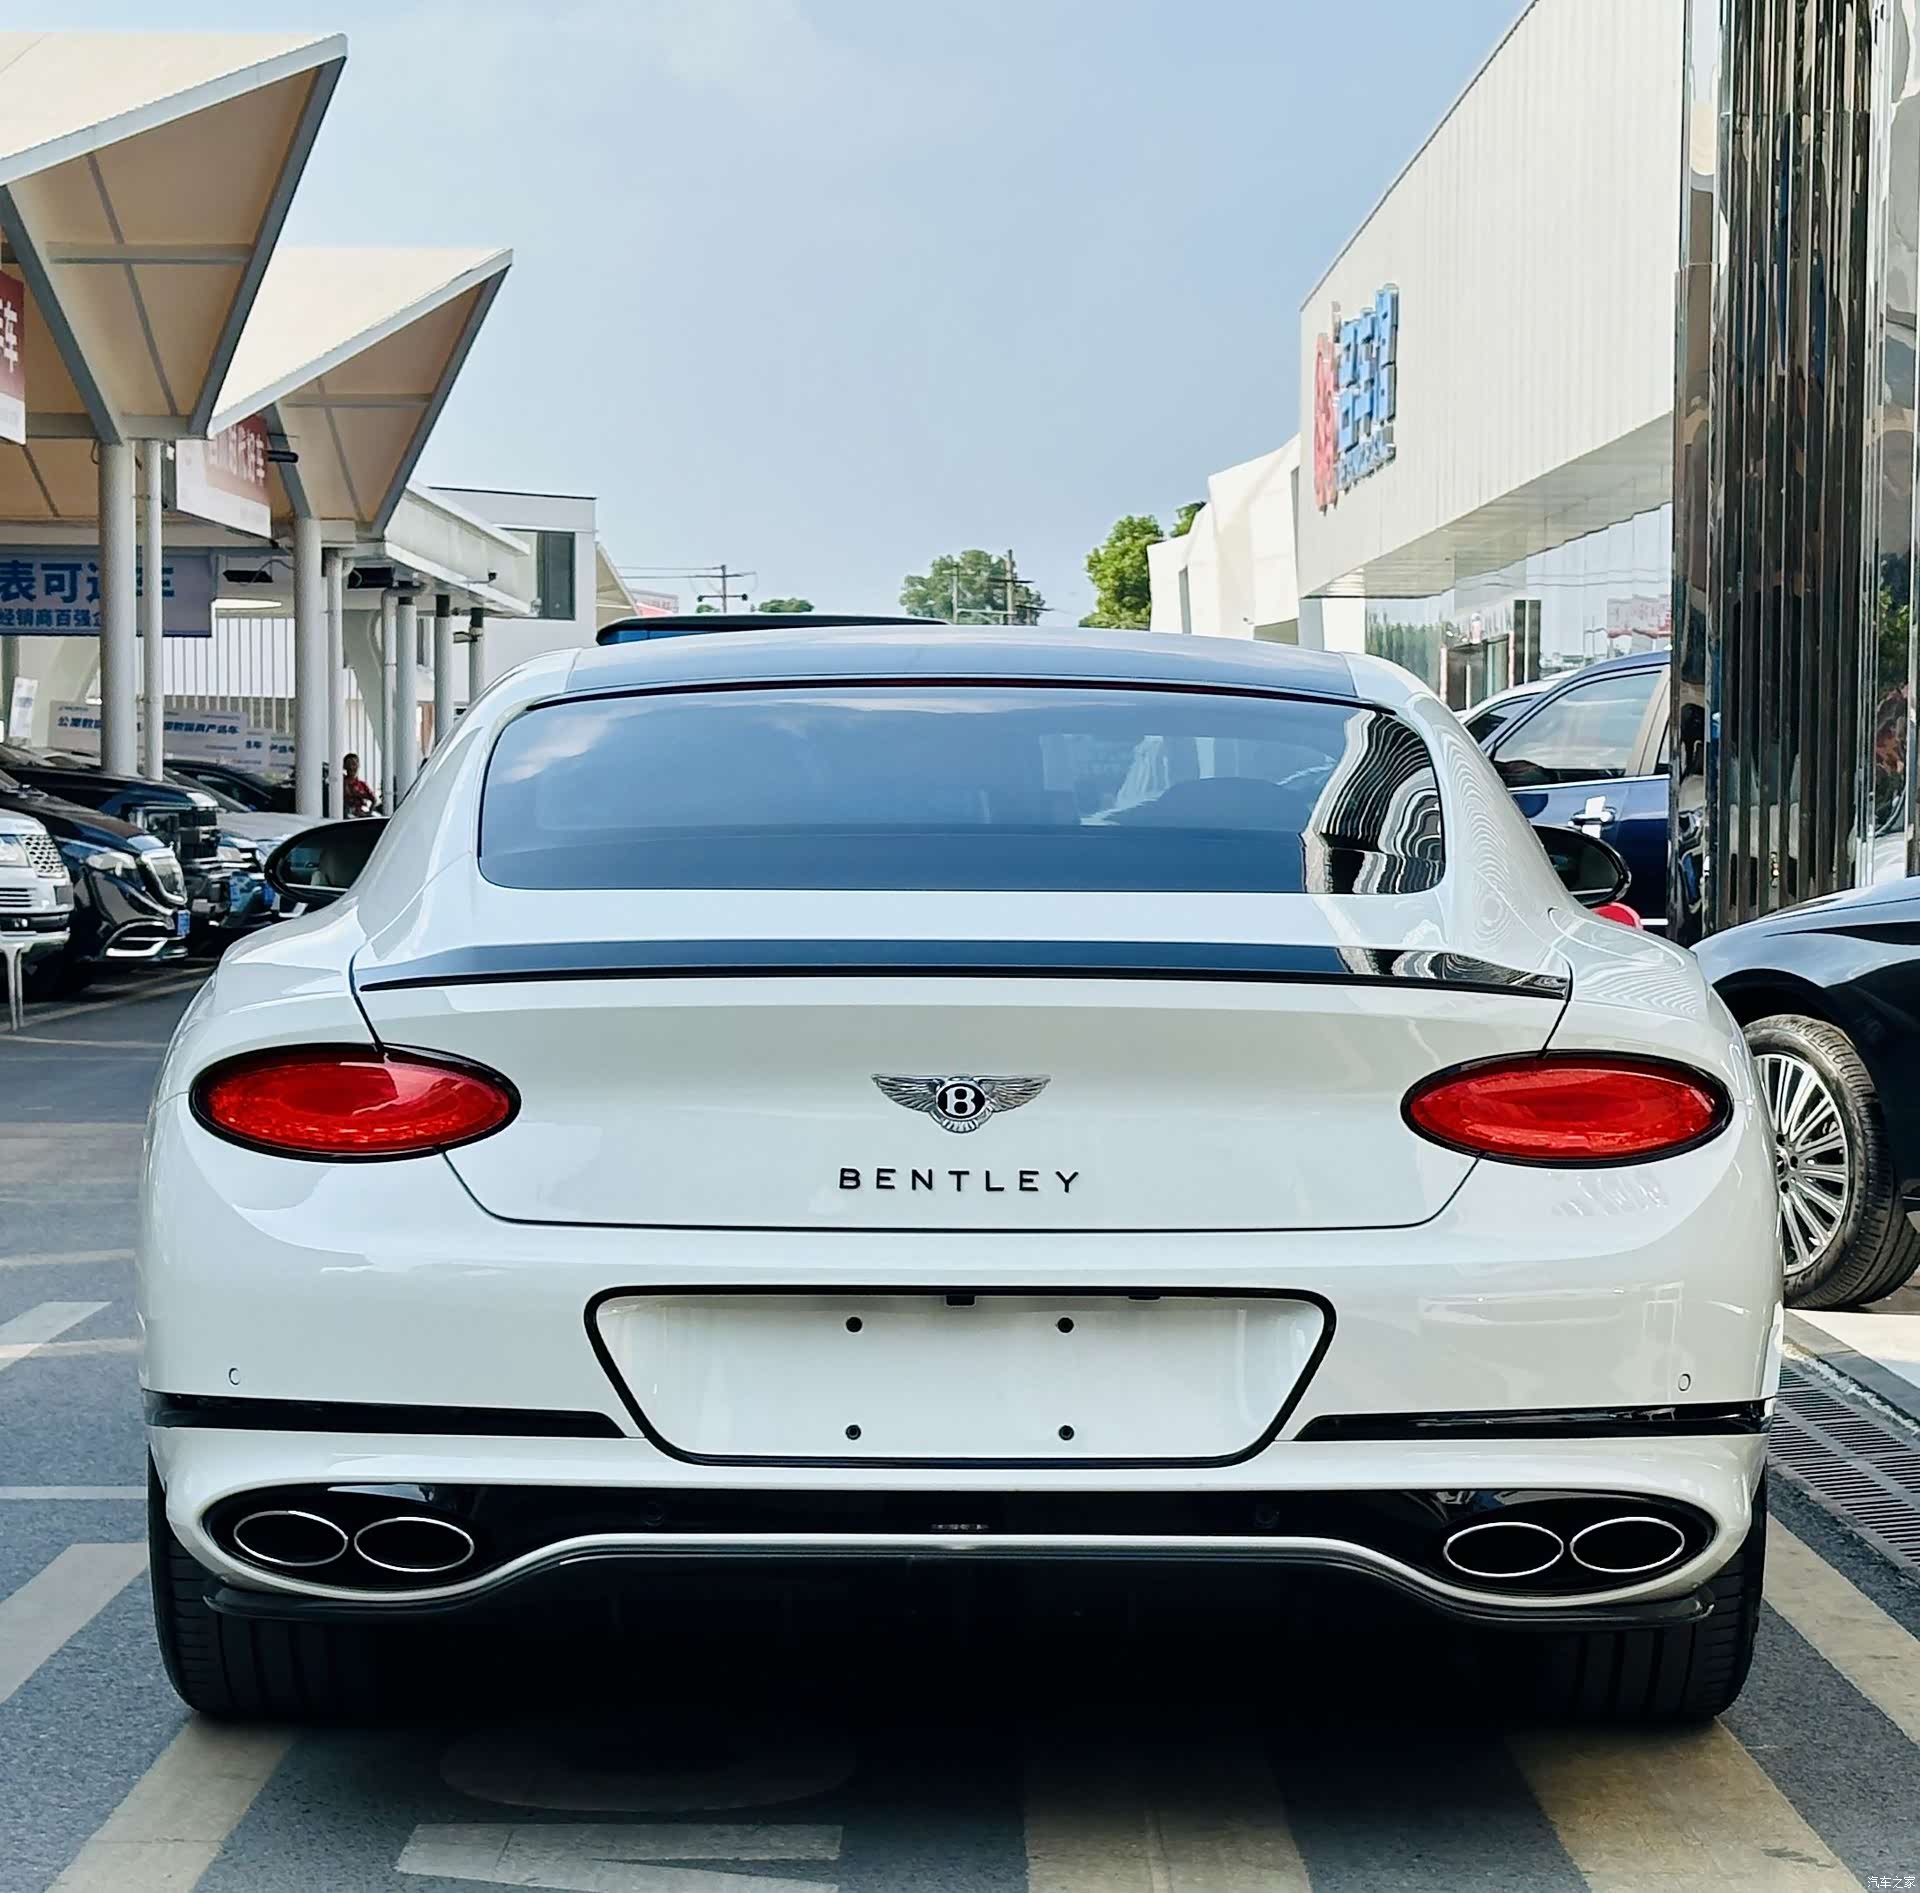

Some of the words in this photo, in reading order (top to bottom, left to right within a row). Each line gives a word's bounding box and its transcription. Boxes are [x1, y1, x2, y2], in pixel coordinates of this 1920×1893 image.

[0, 299, 18, 373] 车
[945, 1086, 976, 1117] B
[839, 1167, 1079, 1193] BENTLEY
